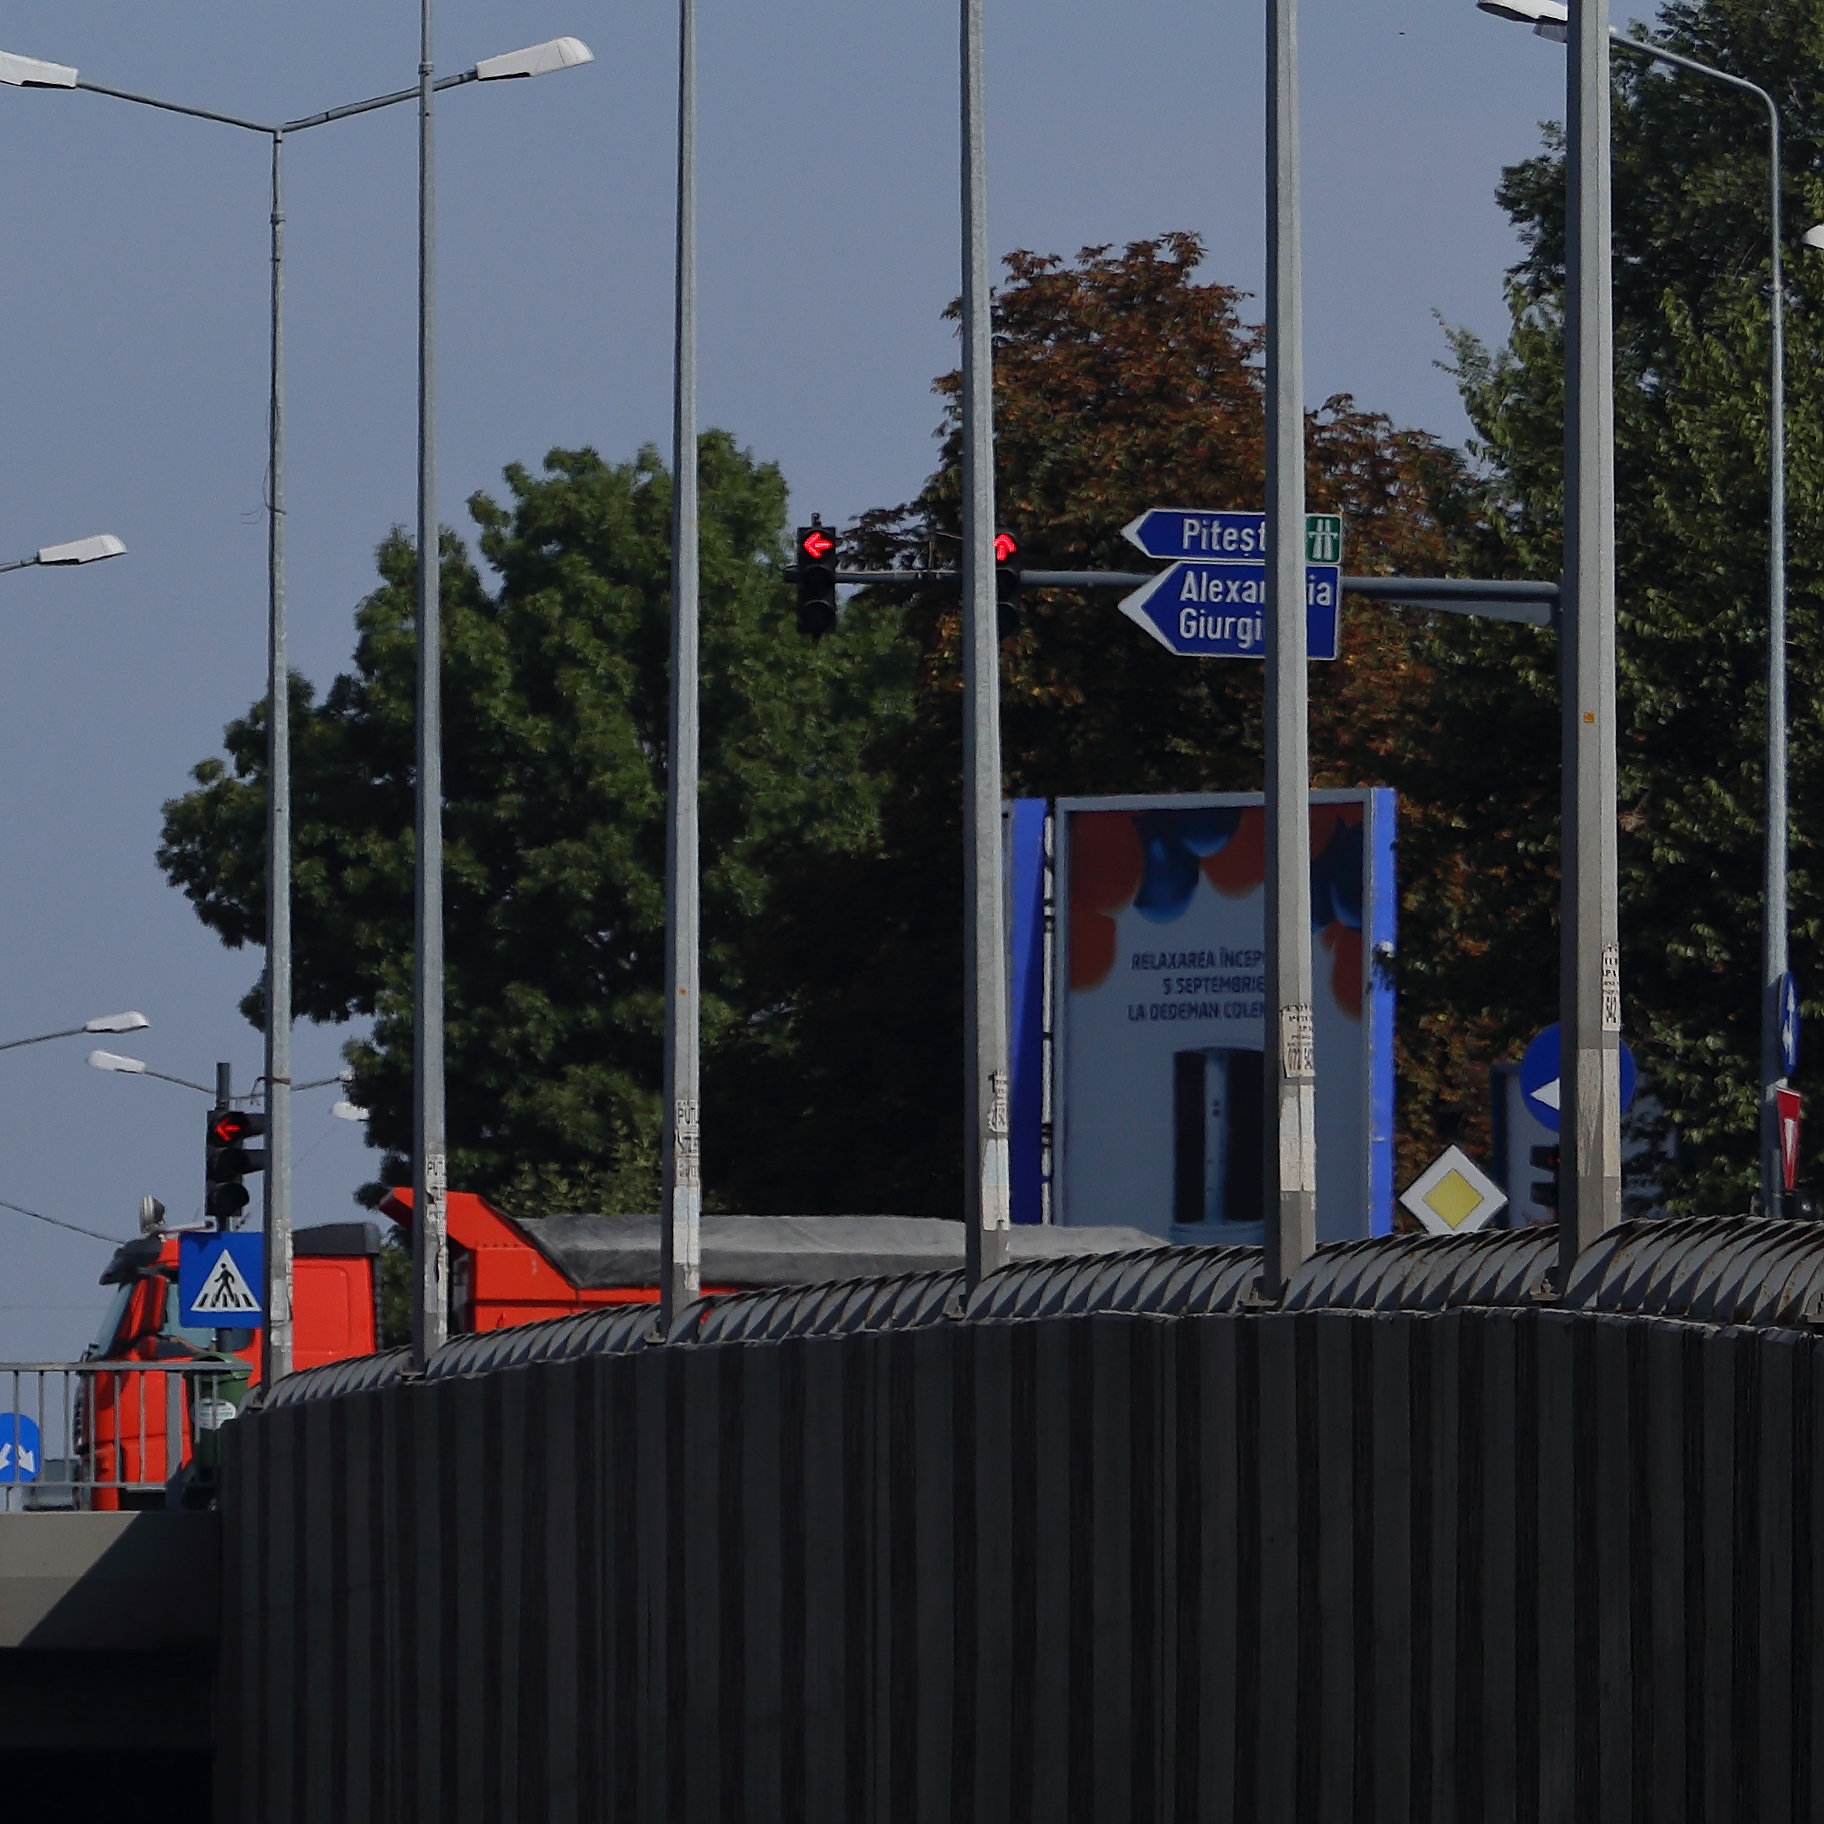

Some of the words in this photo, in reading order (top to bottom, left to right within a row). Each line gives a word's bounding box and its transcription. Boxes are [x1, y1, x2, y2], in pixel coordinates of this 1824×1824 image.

[1182, 518, 1266, 557] Piteșt
[1179, 570, 1332, 606] Alexaia
[1178, 607, 1264, 649] Giurgi
[1132, 951, 1215, 971] RELAXAREA
[1219, 946, 1264, 969] ÎNCEP
[1163, 978, 1172, 995] 5
[1177, 975, 1265, 994] SEPTEMBRIE
[1128, 1001, 1145, 1021] LA
[1149, 999, 1219, 1021] DEDEMAN
